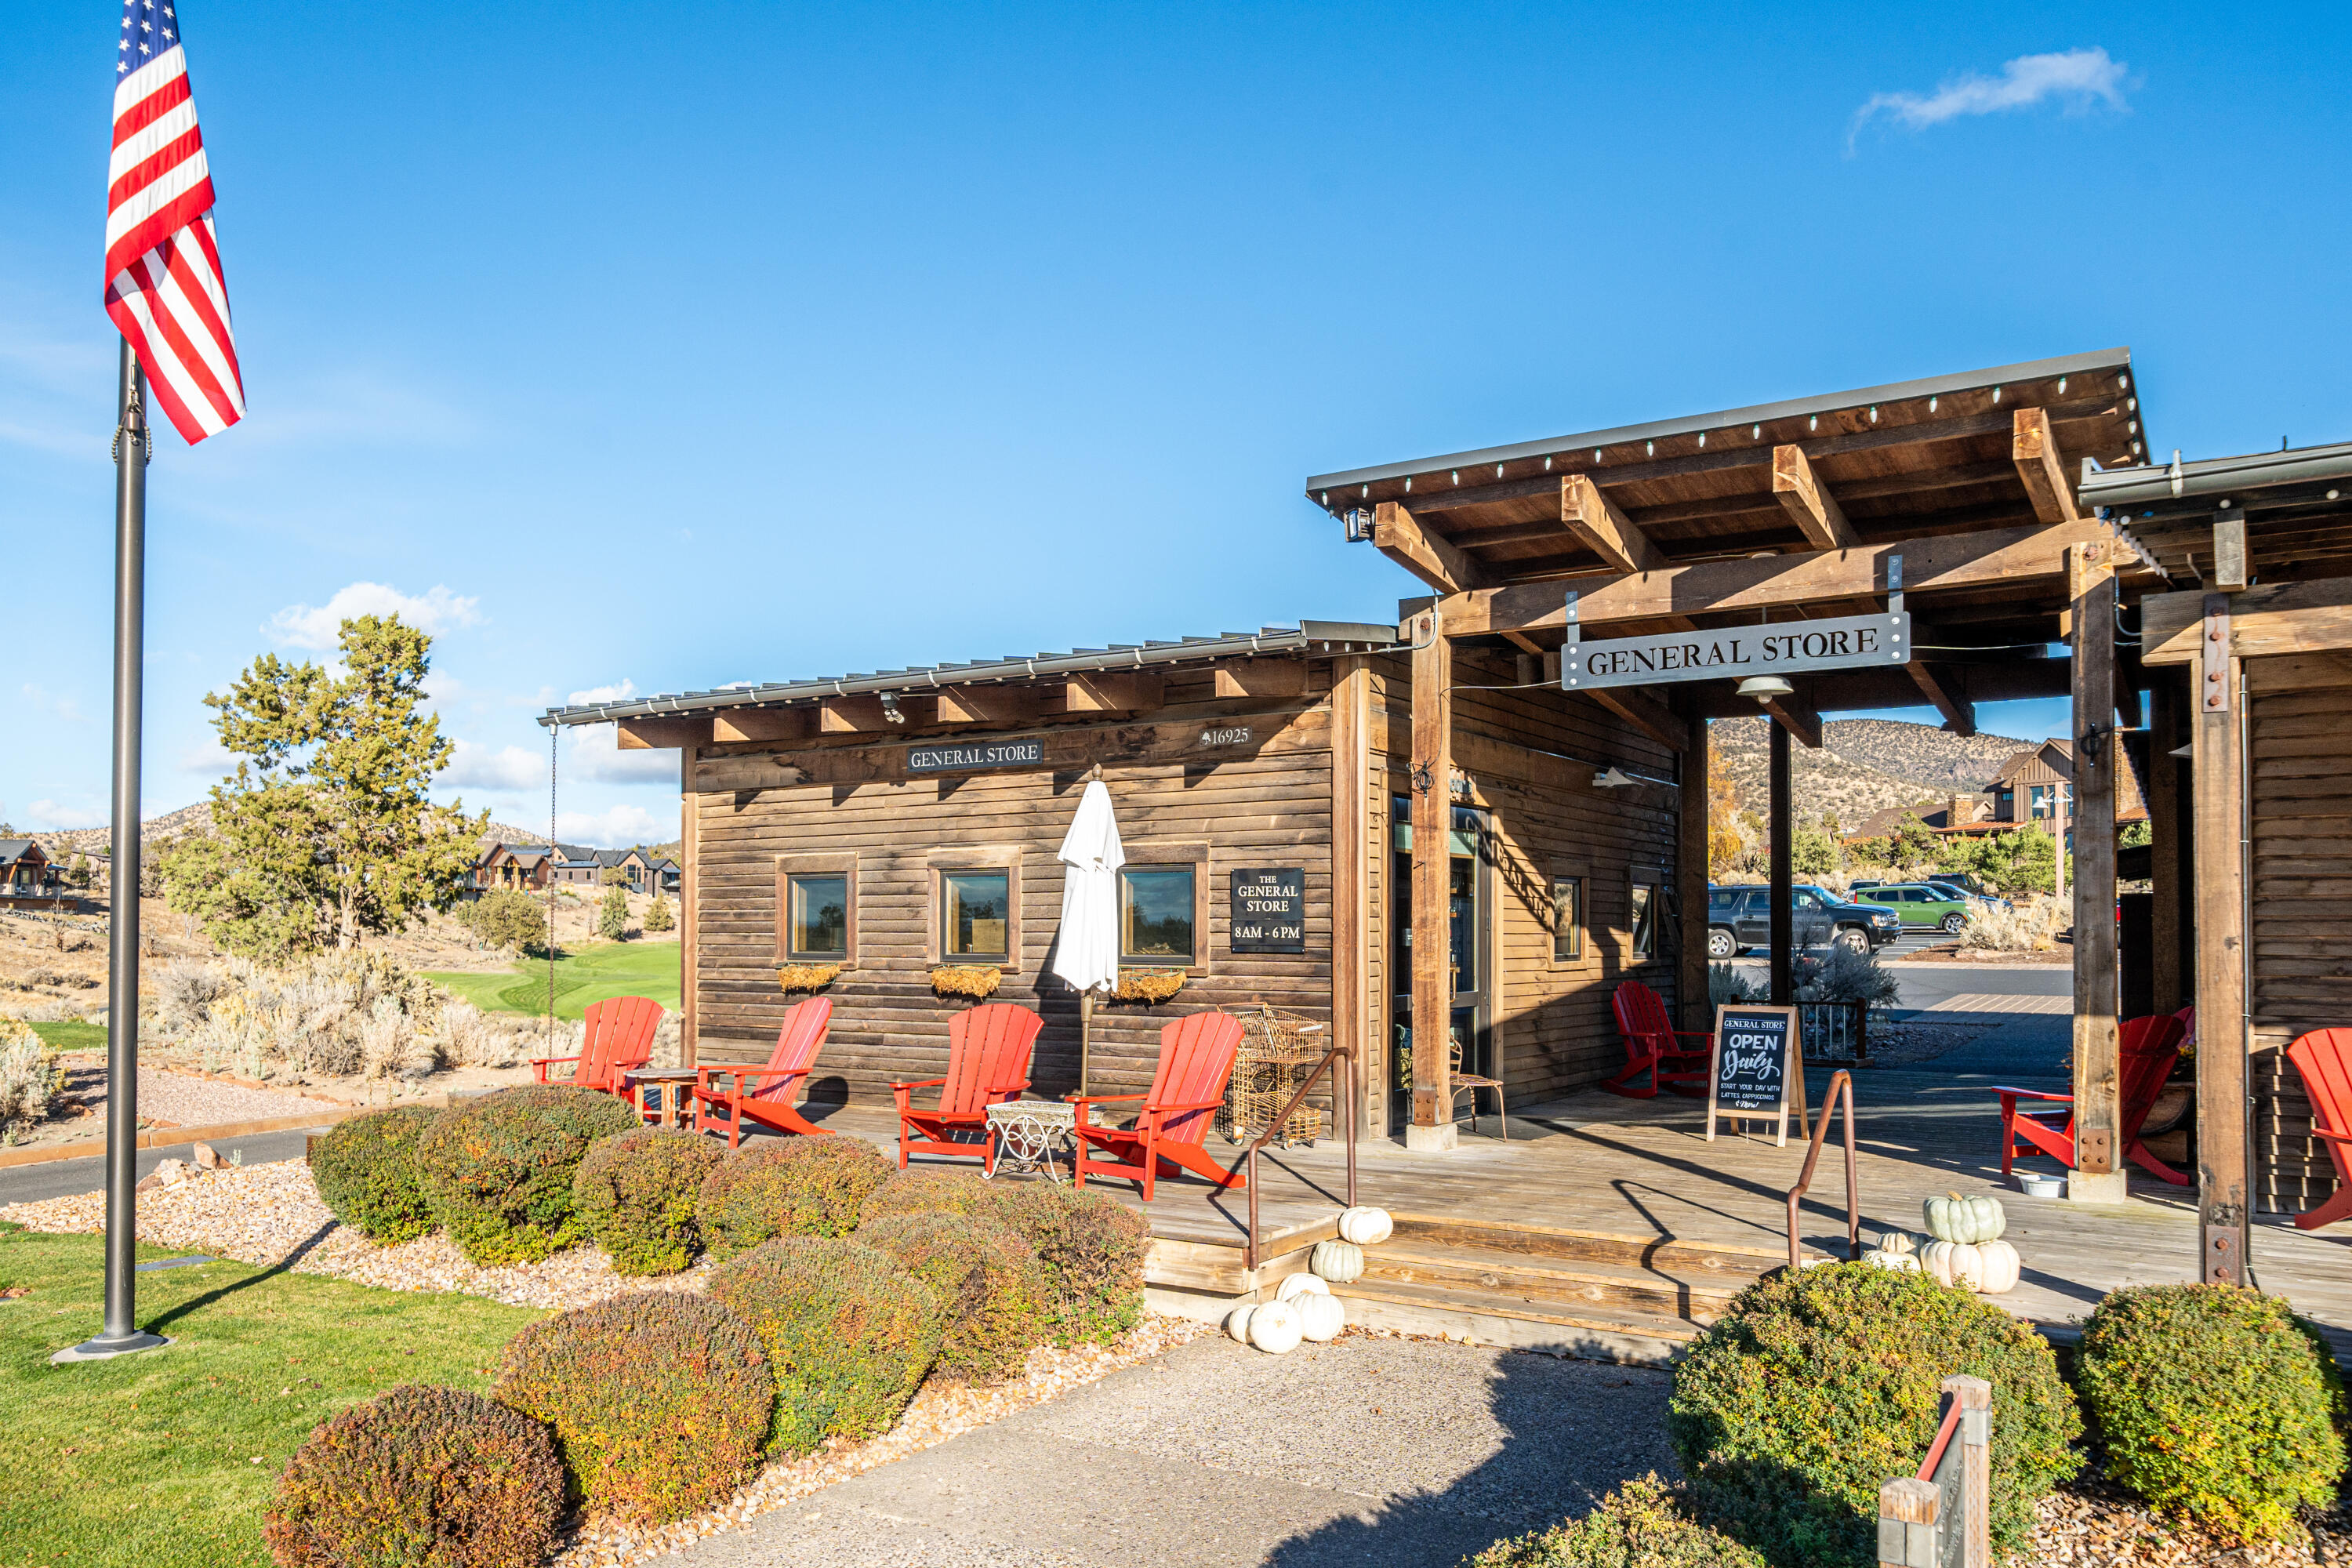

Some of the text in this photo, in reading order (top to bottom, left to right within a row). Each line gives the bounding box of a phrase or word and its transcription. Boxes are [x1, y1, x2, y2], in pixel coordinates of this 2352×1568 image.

[1587, 628, 1878, 677] GENERAL STORE
[1212, 728, 1248, 744] 16925
[911, 745, 1038, 768] GENERAL STORE
[1238, 886, 1298, 897] GENERAL
[1247, 900, 1290, 912] STORE
[1724, 1019, 1759, 1029] GENERAL
[1730, 1034, 1779, 1051] OPEN
[1721, 1049, 1780, 1080] Daily
